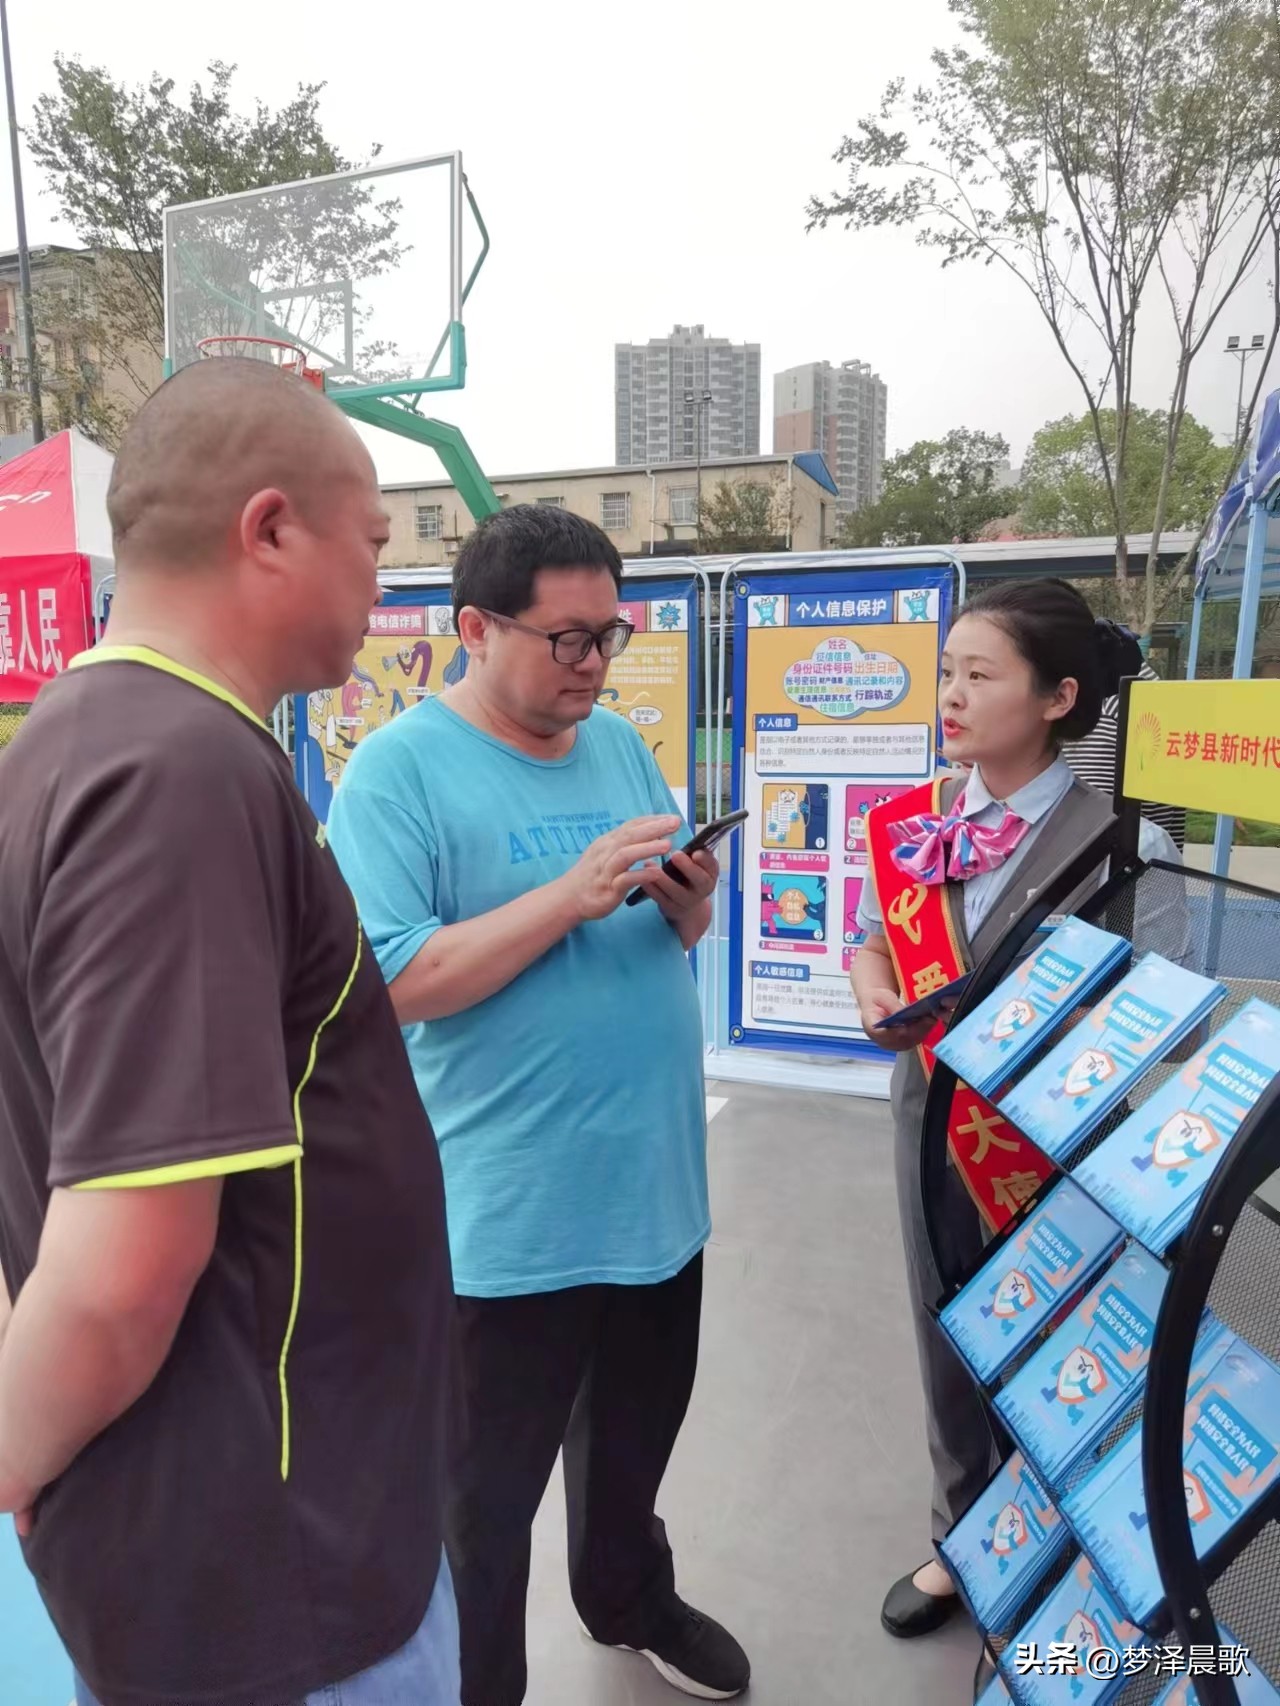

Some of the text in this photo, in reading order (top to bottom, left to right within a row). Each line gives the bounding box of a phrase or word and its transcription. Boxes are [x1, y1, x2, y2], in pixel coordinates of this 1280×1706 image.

[796, 599, 887, 618] 个人信息保护
[828, 640, 846, 650] 姓名
[793, 662, 898, 674] 身份证件号码 出生日期
[855, 690, 893, 700] 行踪轨迹
[758, 718, 791, 728] 个人信息
[1166, 731, 1280, 769] 云梦县新时代
[754, 965, 804, 978] 个人敏感信息
